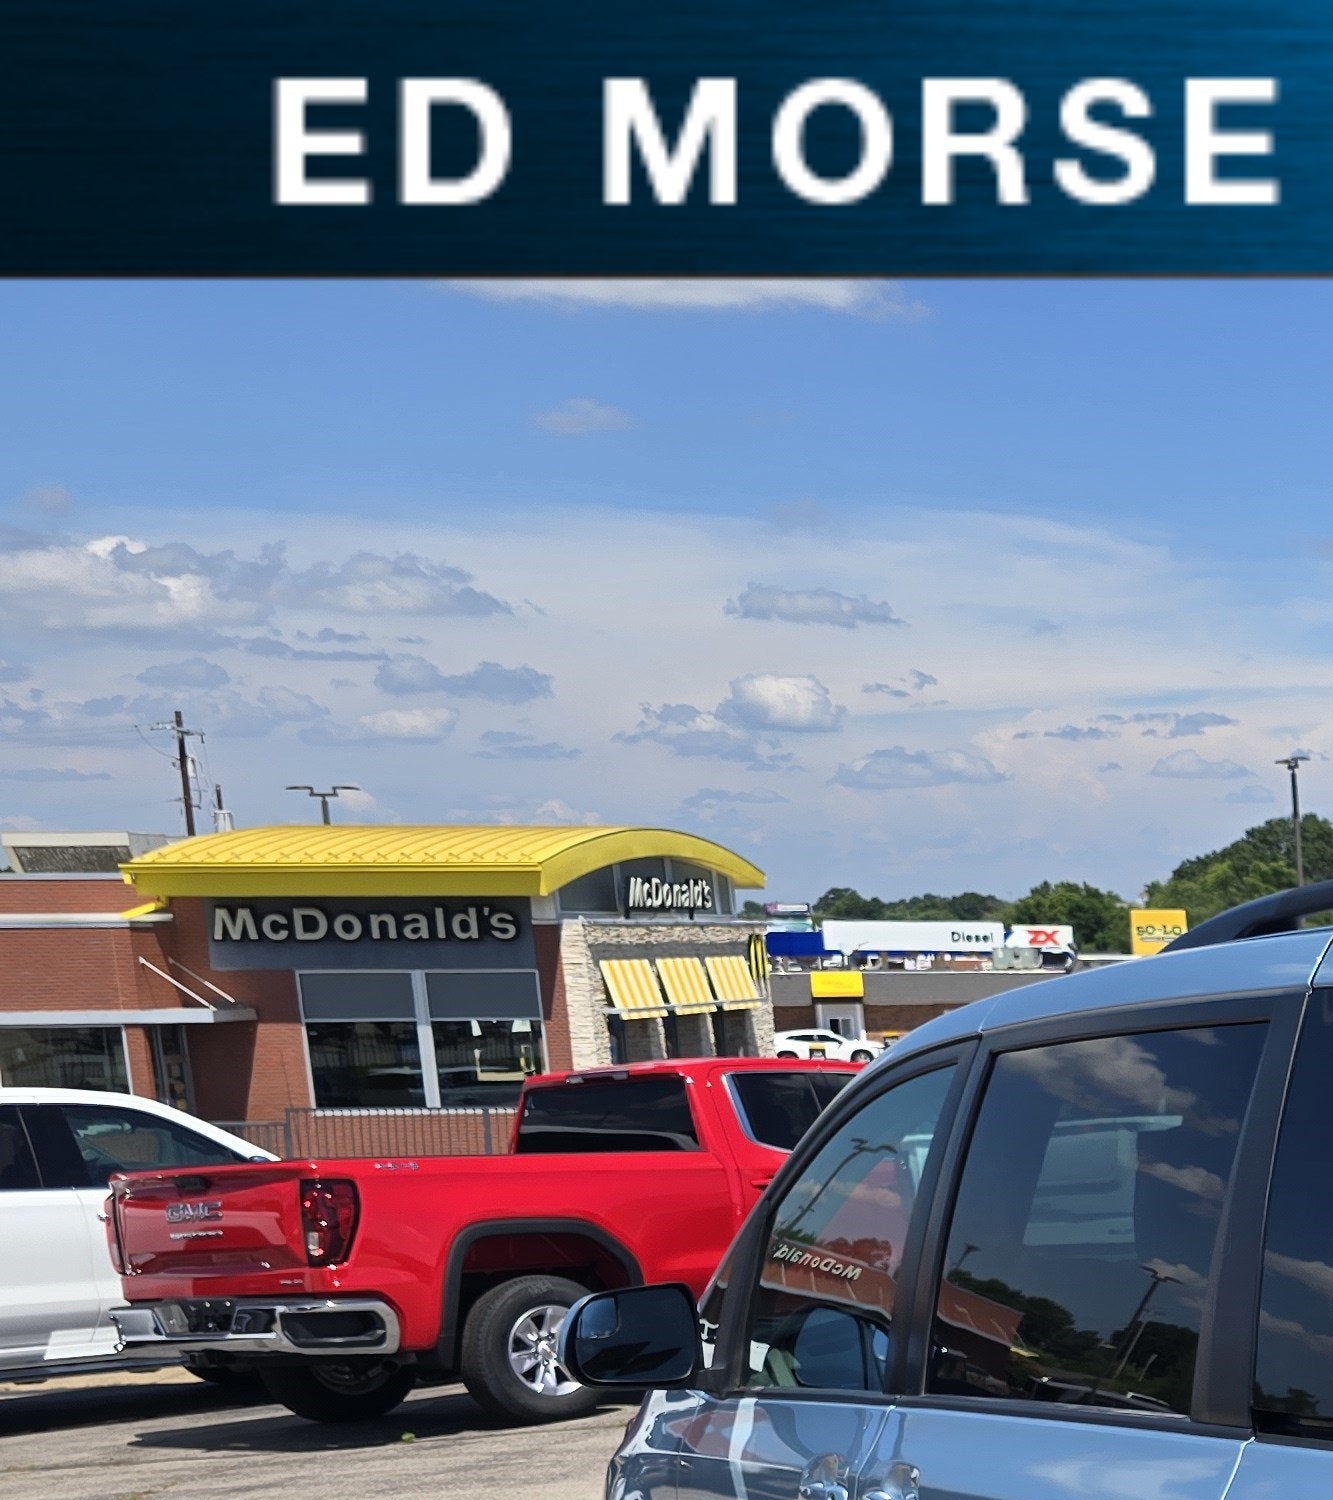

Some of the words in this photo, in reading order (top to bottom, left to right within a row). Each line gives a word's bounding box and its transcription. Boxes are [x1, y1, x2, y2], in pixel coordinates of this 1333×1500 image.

[629, 876, 712, 908] McDonald's
[213, 906, 517, 941] McDonald's
[951, 931, 994, 943] Diesel
[165, 1201, 223, 1223] GMC
